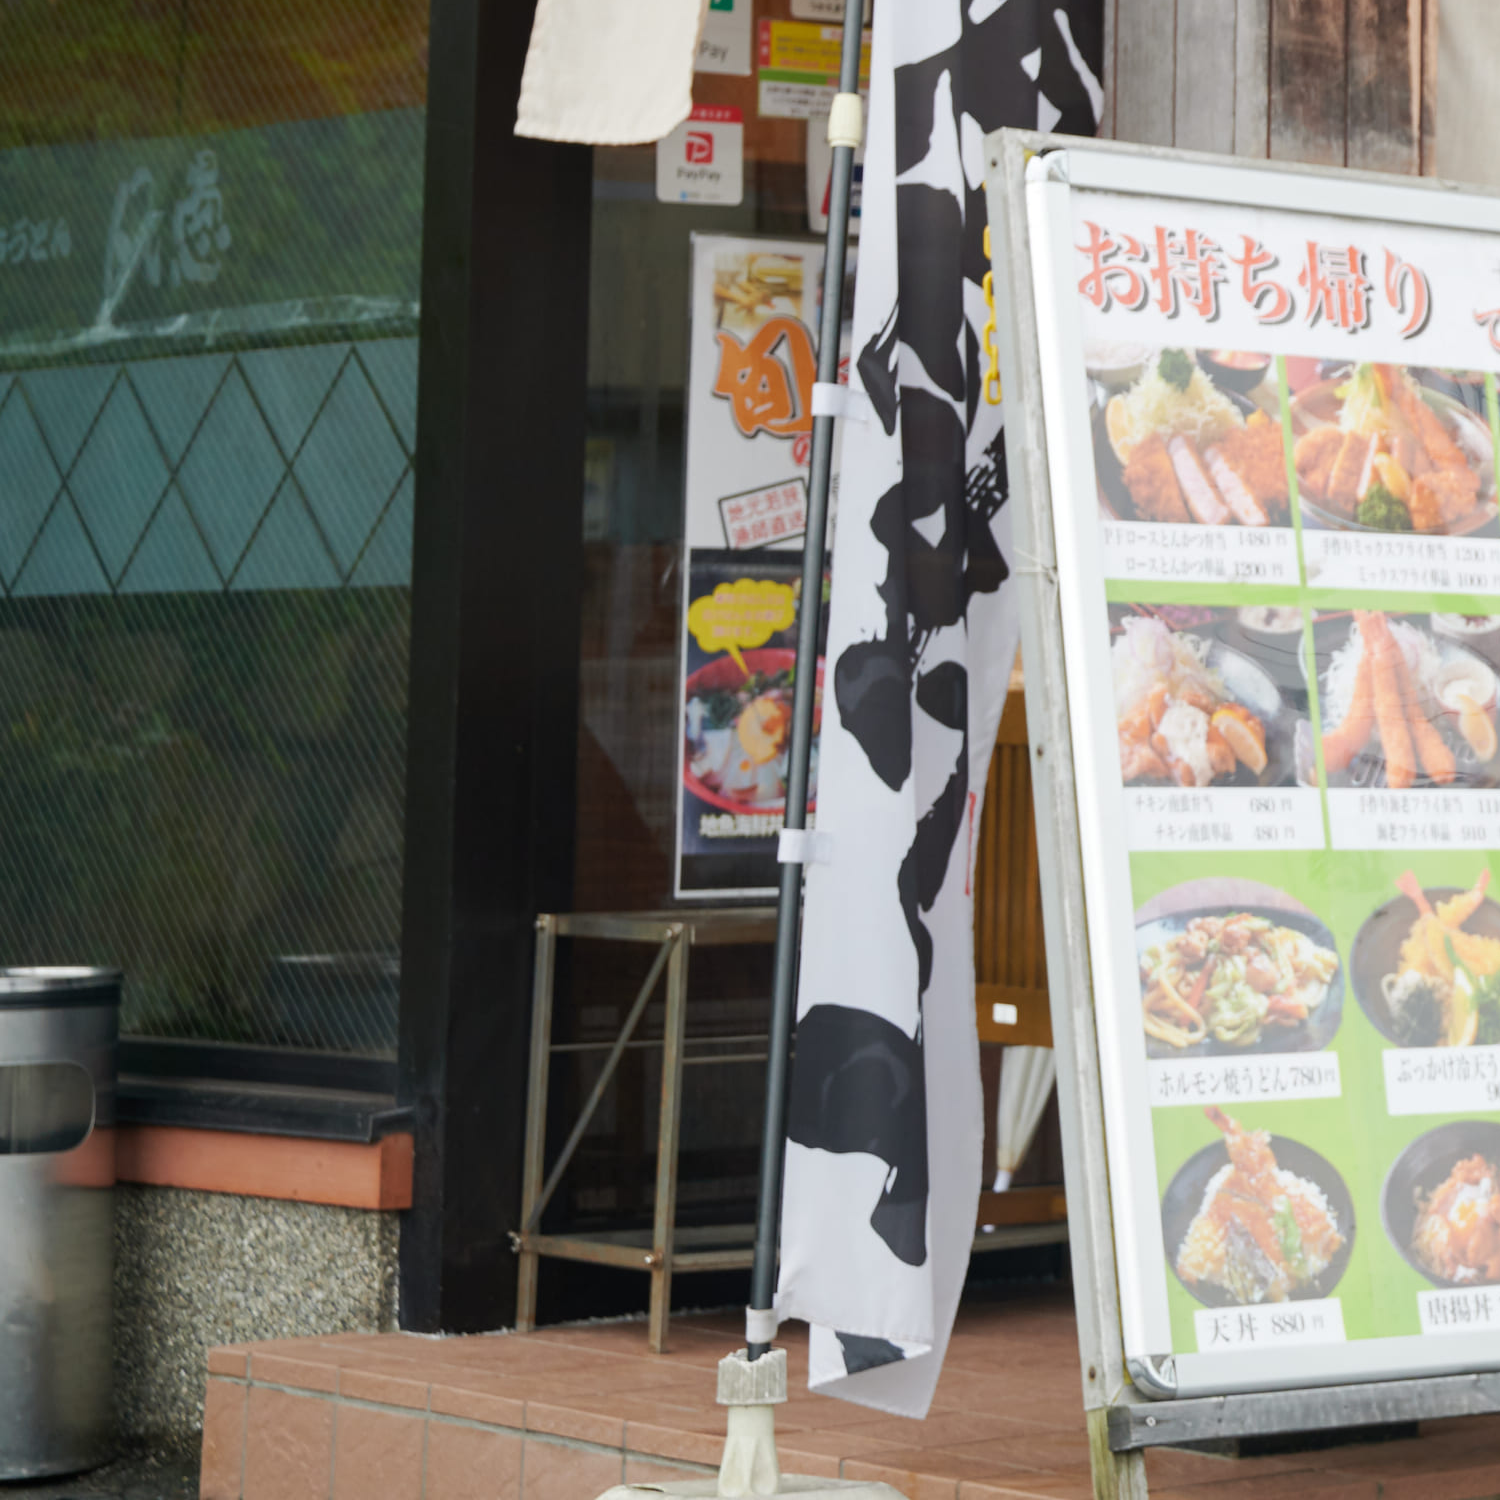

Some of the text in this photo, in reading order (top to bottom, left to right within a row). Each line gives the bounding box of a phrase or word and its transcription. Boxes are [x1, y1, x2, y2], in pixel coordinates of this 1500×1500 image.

[676, 165, 723, 186] PayPay
[1076, 220, 1432, 338] お持ち帰り
[1206, 1311, 1260, 1347] 天丼
